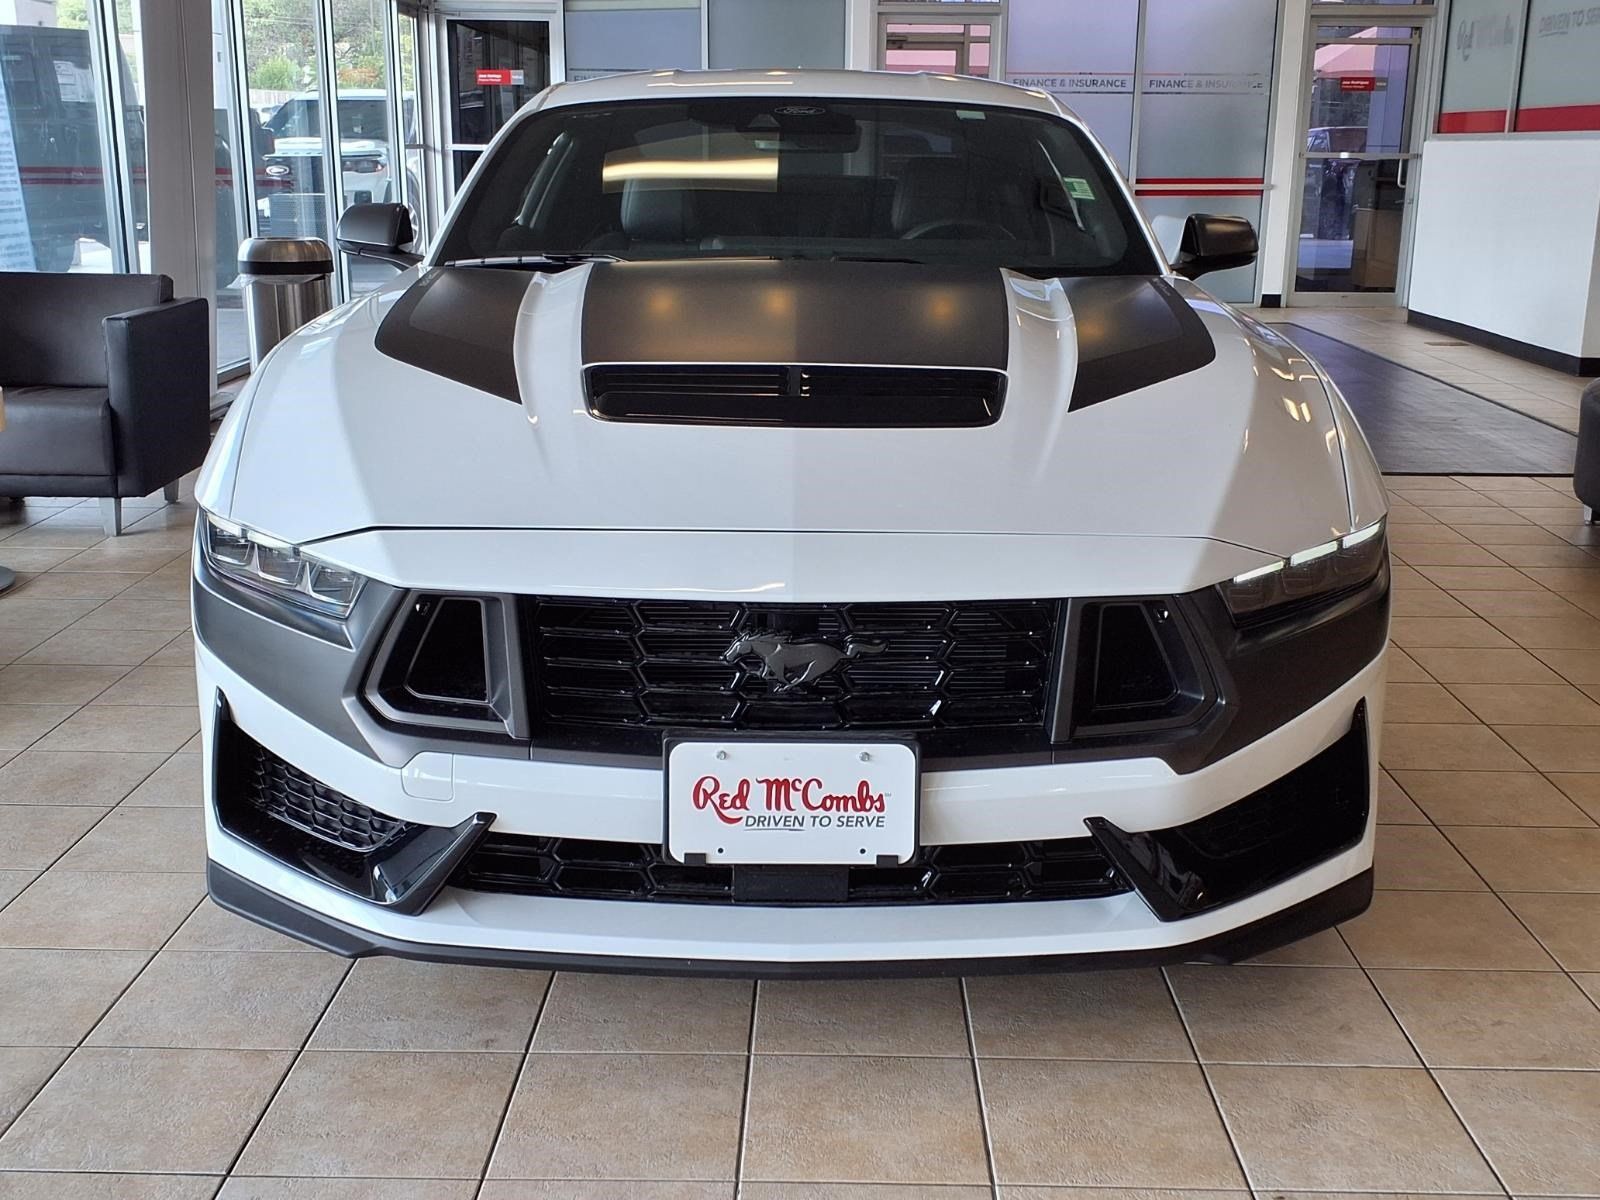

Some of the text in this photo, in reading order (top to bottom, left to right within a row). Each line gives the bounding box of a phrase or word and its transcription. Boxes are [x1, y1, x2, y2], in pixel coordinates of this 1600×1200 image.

[1012, 78, 1058, 88] FINANCE
[1069, 78, 1127, 88] INSURANCE
[1149, 79, 1194, 89] FINANCE
[692, 775, 750, 825] Red
[756, 777, 886, 813] McCombs
[745, 815, 885, 828] DRIVEN TO SERVE
